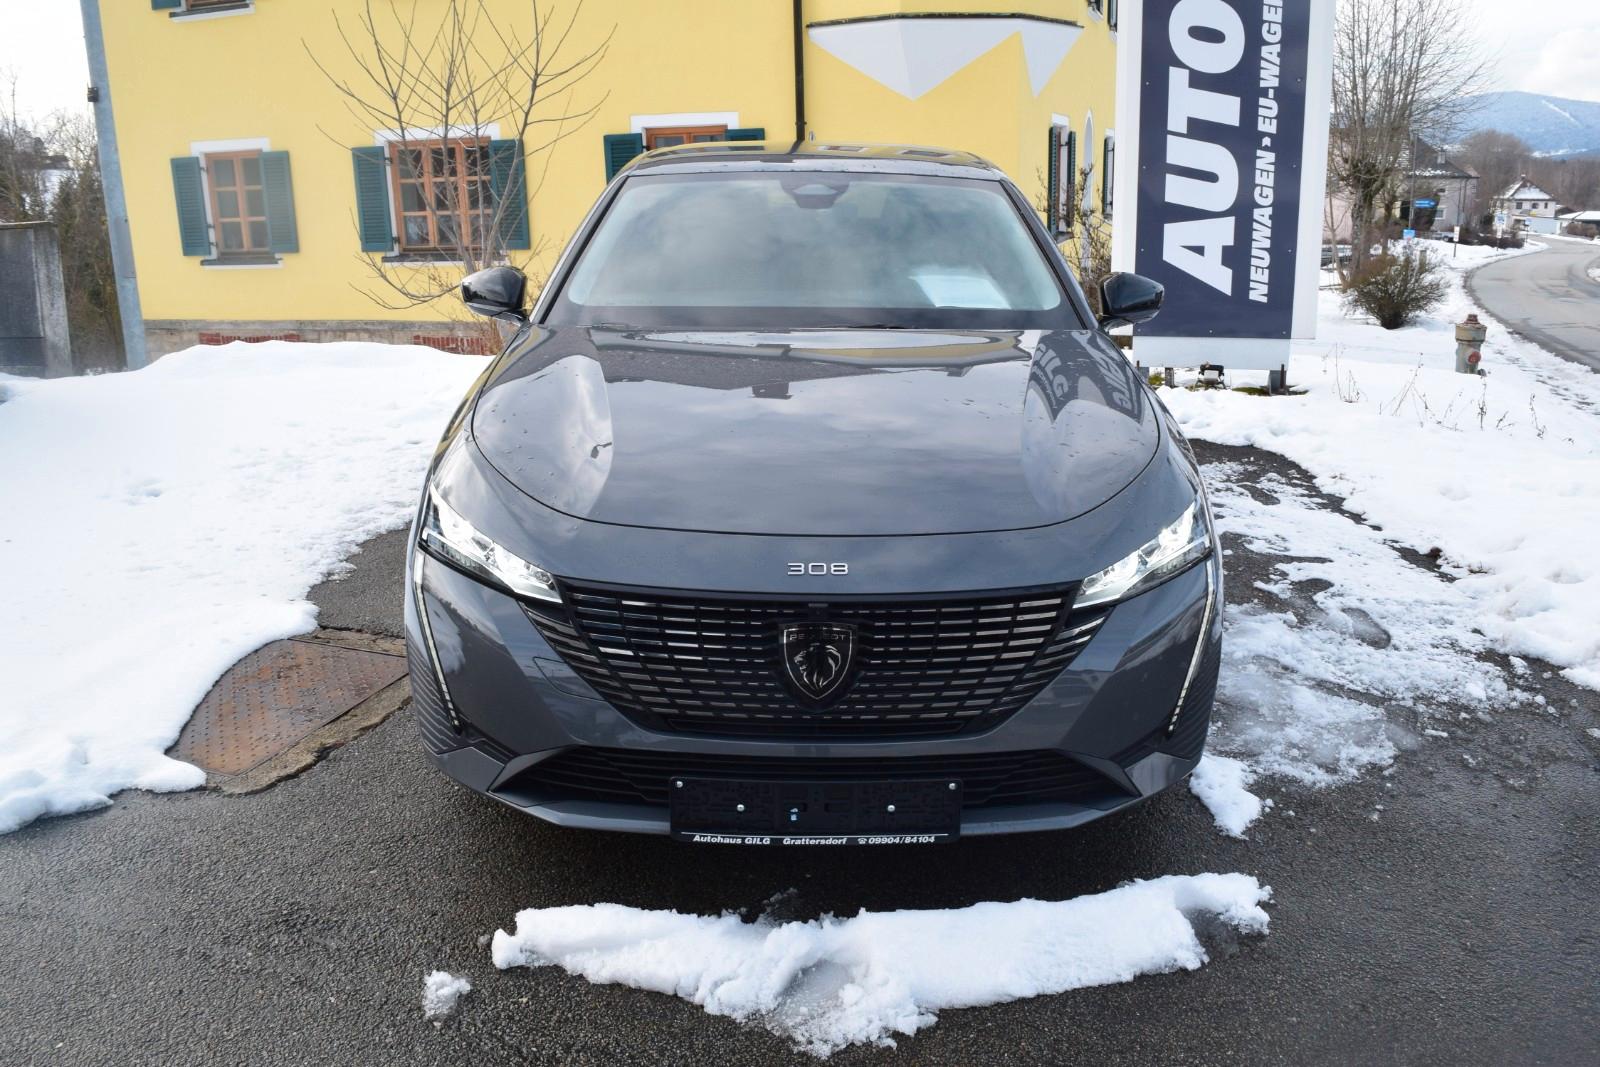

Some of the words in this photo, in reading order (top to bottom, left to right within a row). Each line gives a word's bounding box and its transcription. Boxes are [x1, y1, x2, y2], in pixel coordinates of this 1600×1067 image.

[1162, 0, 1246, 297] AUTO
[1249, 149, 1276, 303] NEUWAGEN
[787, 562, 849, 575] 308
[692, 834, 742, 845] Autohaus
[744, 837, 771, 845] GILG
[782, 837, 848, 845] Grattersdorf
[868, 835, 936, 845] 09904/84104
